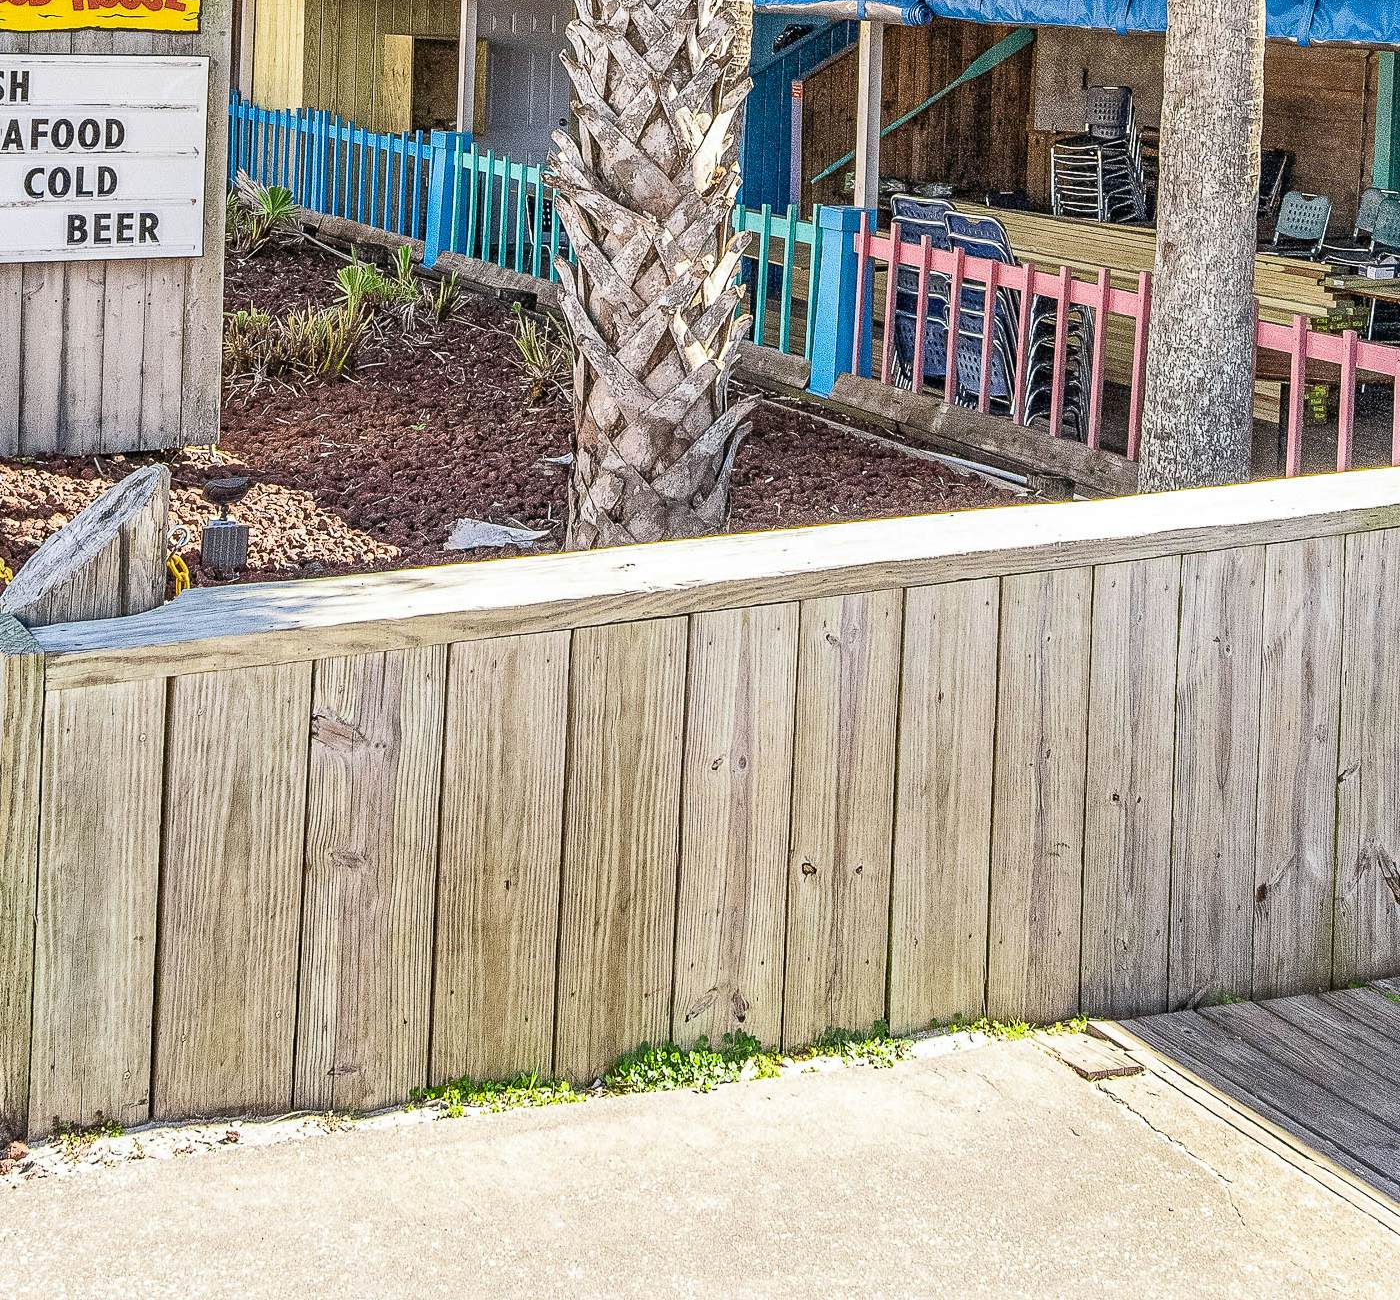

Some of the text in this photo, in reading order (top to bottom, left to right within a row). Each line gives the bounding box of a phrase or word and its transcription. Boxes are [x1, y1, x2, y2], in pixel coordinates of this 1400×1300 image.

[0, 70, 30, 102] H
[0, 118, 125, 151] AFOOD
[23, 166, 118, 199] COLD
[66, 212, 160, 245] BEER
